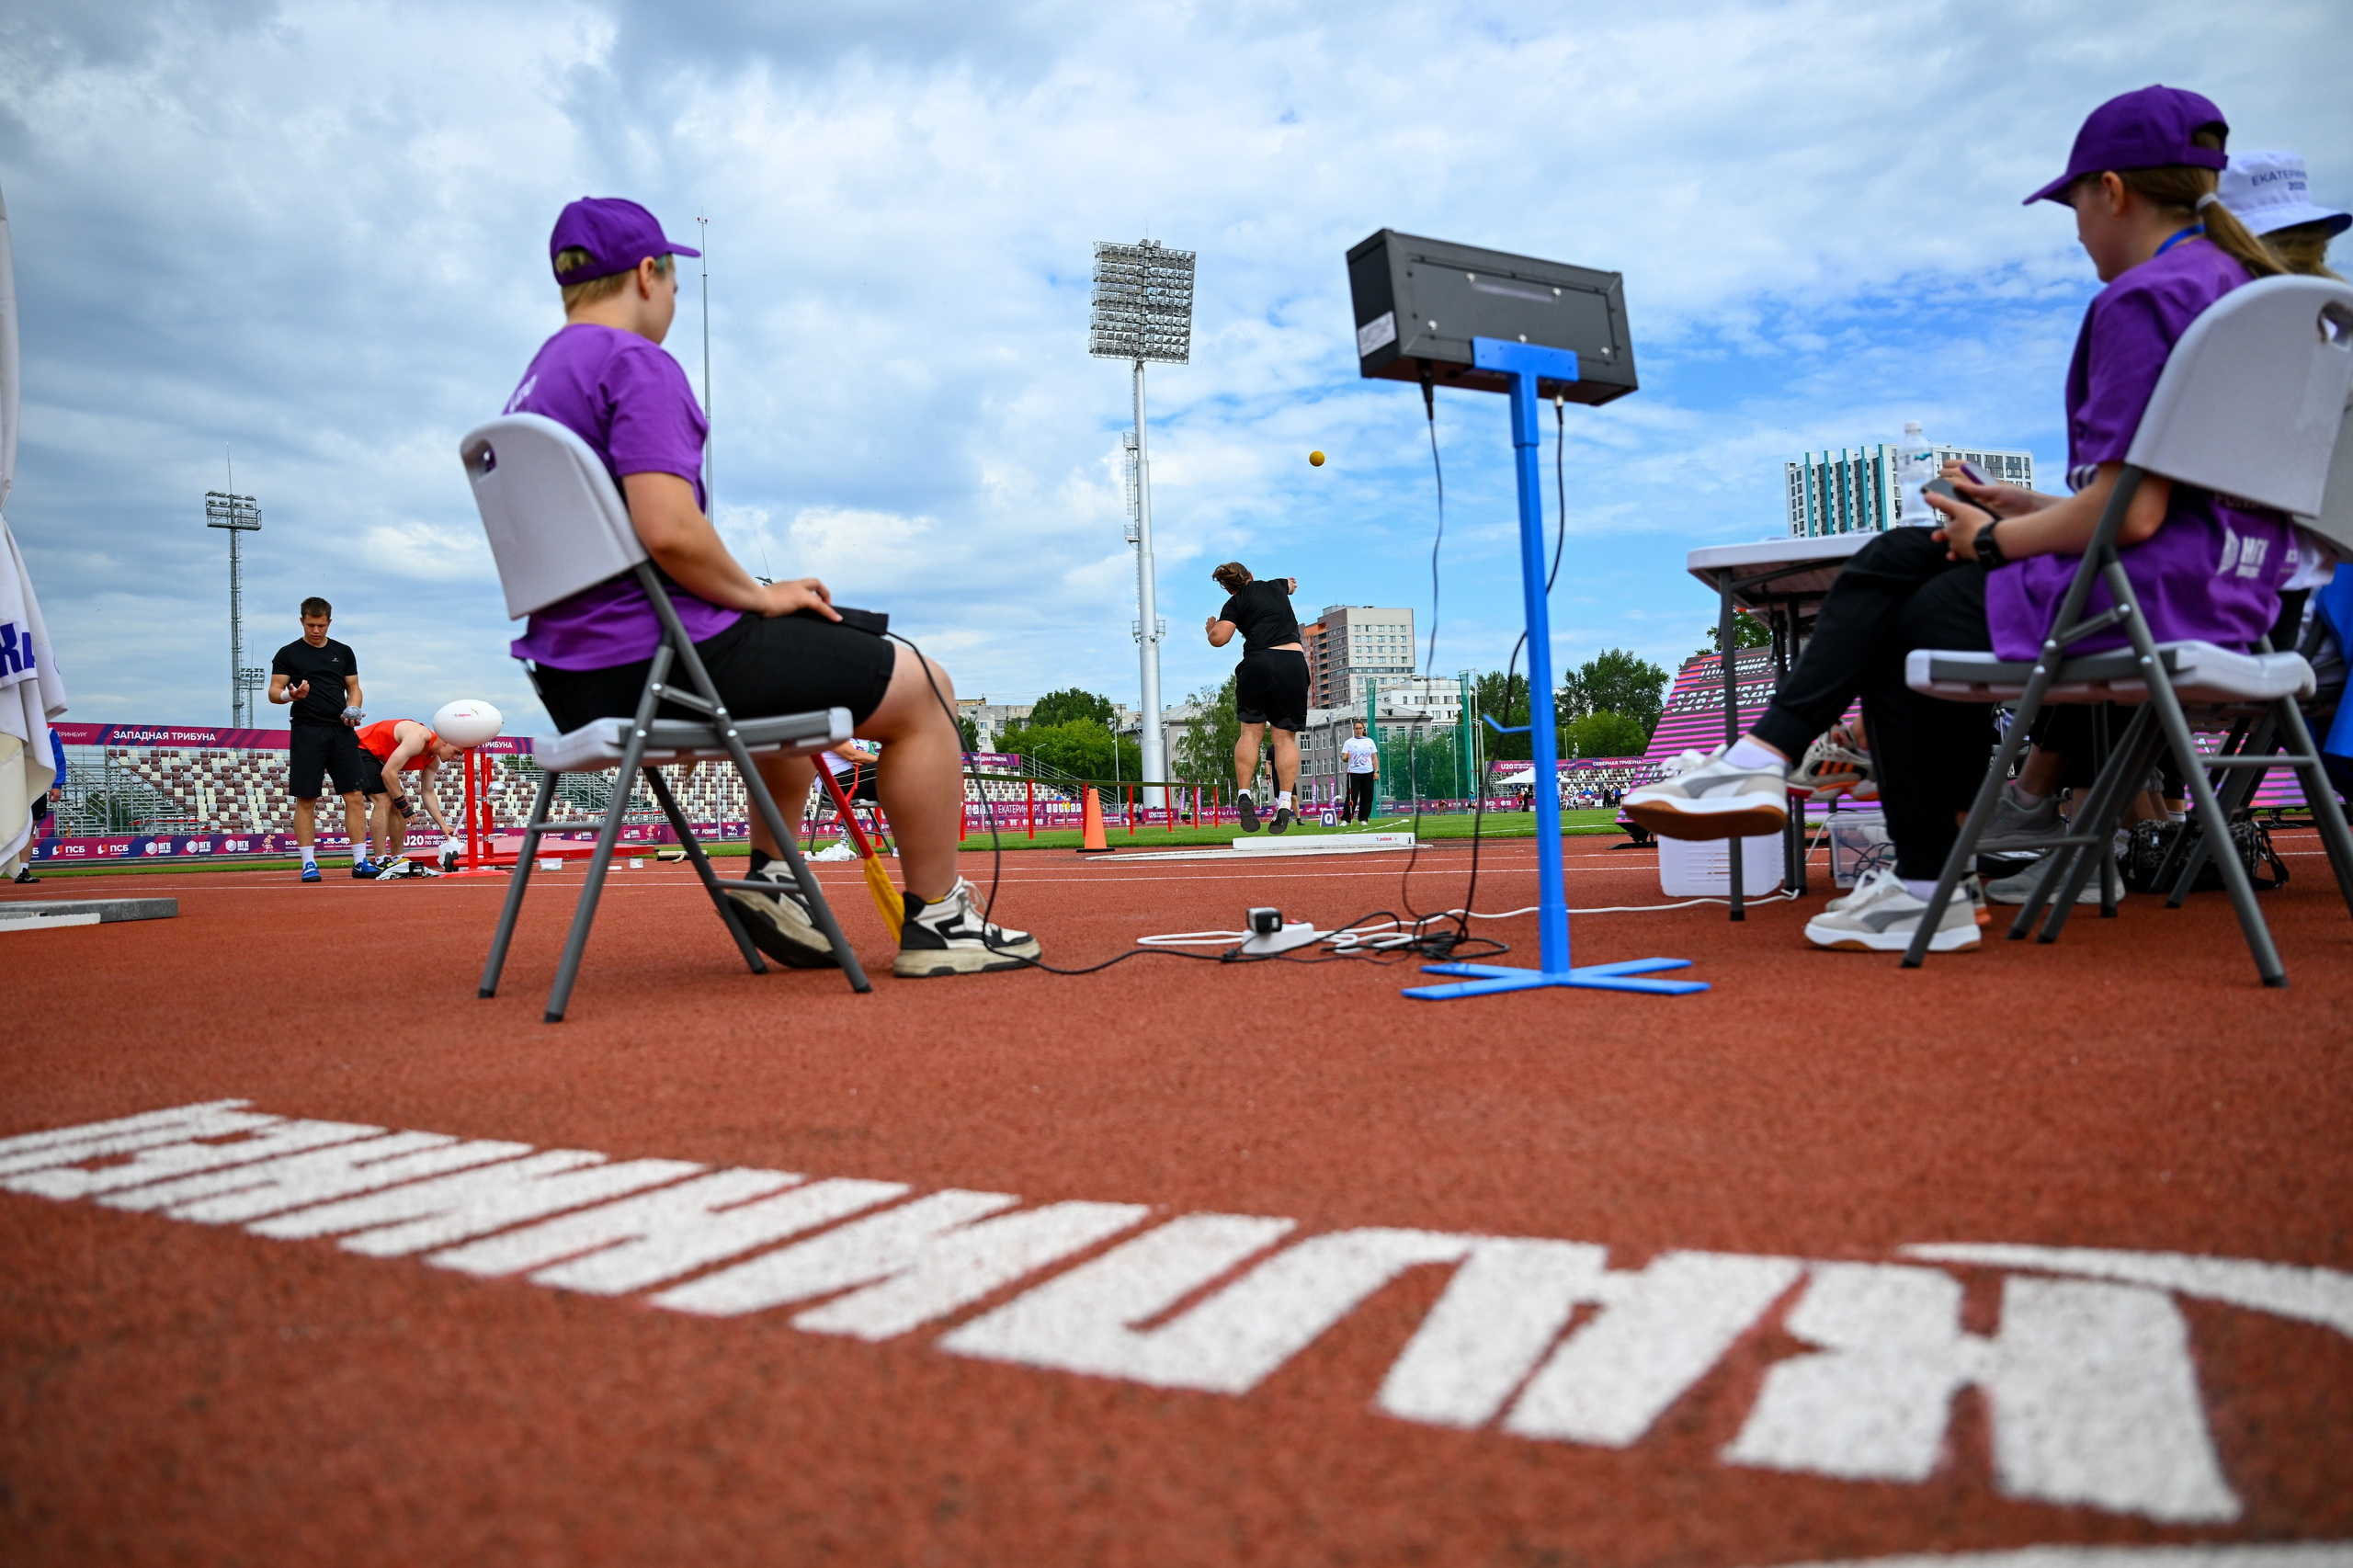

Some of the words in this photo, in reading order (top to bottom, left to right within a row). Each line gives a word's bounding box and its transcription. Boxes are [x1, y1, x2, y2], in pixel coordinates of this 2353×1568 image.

[113, 730, 169, 742] ЗАПАДНАЯ
[172, 732, 216, 742] ТРИБУНА
[997, 804, 1041, 813] ЕКАТЕРИНУРГ
[1324, 812, 1334, 824] Q
[65, 845, 85, 854] ПСБ
[109, 844, 130, 853] ПСБ
